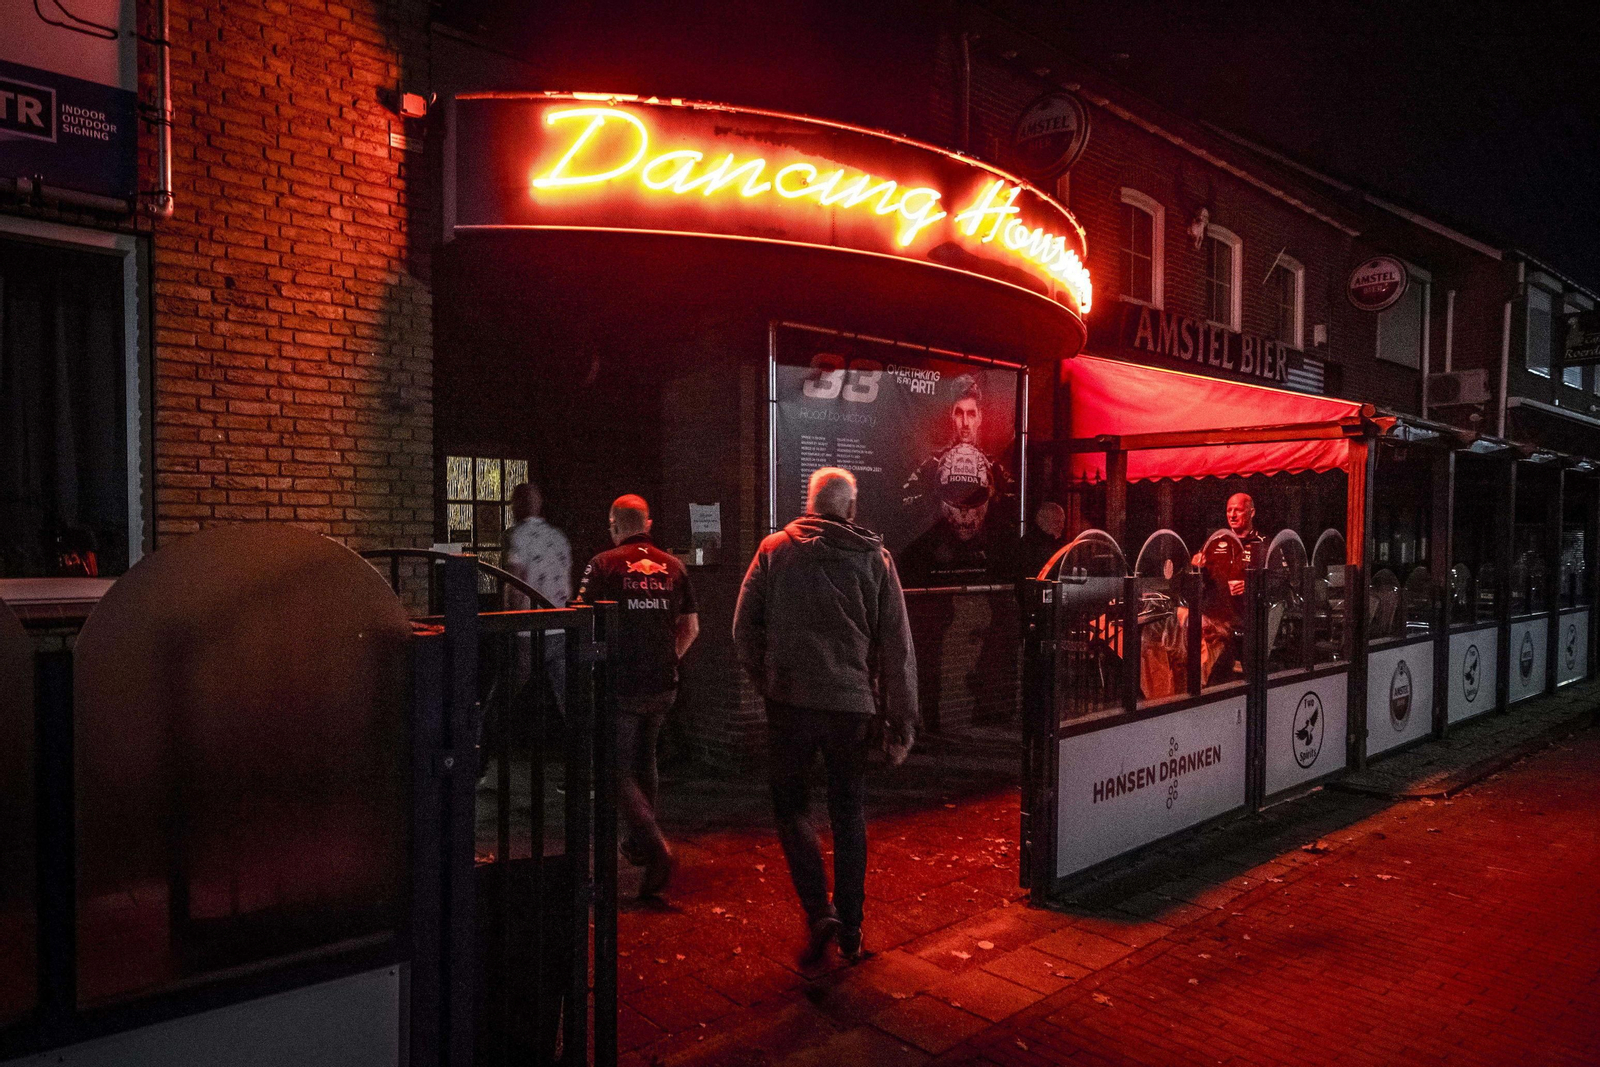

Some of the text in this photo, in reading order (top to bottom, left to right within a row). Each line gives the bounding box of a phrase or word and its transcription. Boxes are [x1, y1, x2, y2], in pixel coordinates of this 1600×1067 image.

[61, 103, 106, 121] INDOOR
[62, 114, 118, 134] OUTDOOR
[62, 124, 110, 141] SIGNING
[533, 106, 946, 246] Dancing
[1354, 272, 1395, 286] AMSTEL
[1133, 305, 1287, 381] AMSTEL BIER
[802, 352, 883, 403] 33
[886, 363, 941, 382] OVERTAKING
[910, 379, 936, 395] ART!
[949, 475, 979, 484] HONDA
[622, 576, 674, 592] Red Bull
[628, 598, 659, 610] Mobil
[1304, 698, 1315, 709] Two
[1299, 748, 1317, 763] Spirits
[1093, 744, 1222, 804] HANSEN DRANKEN
